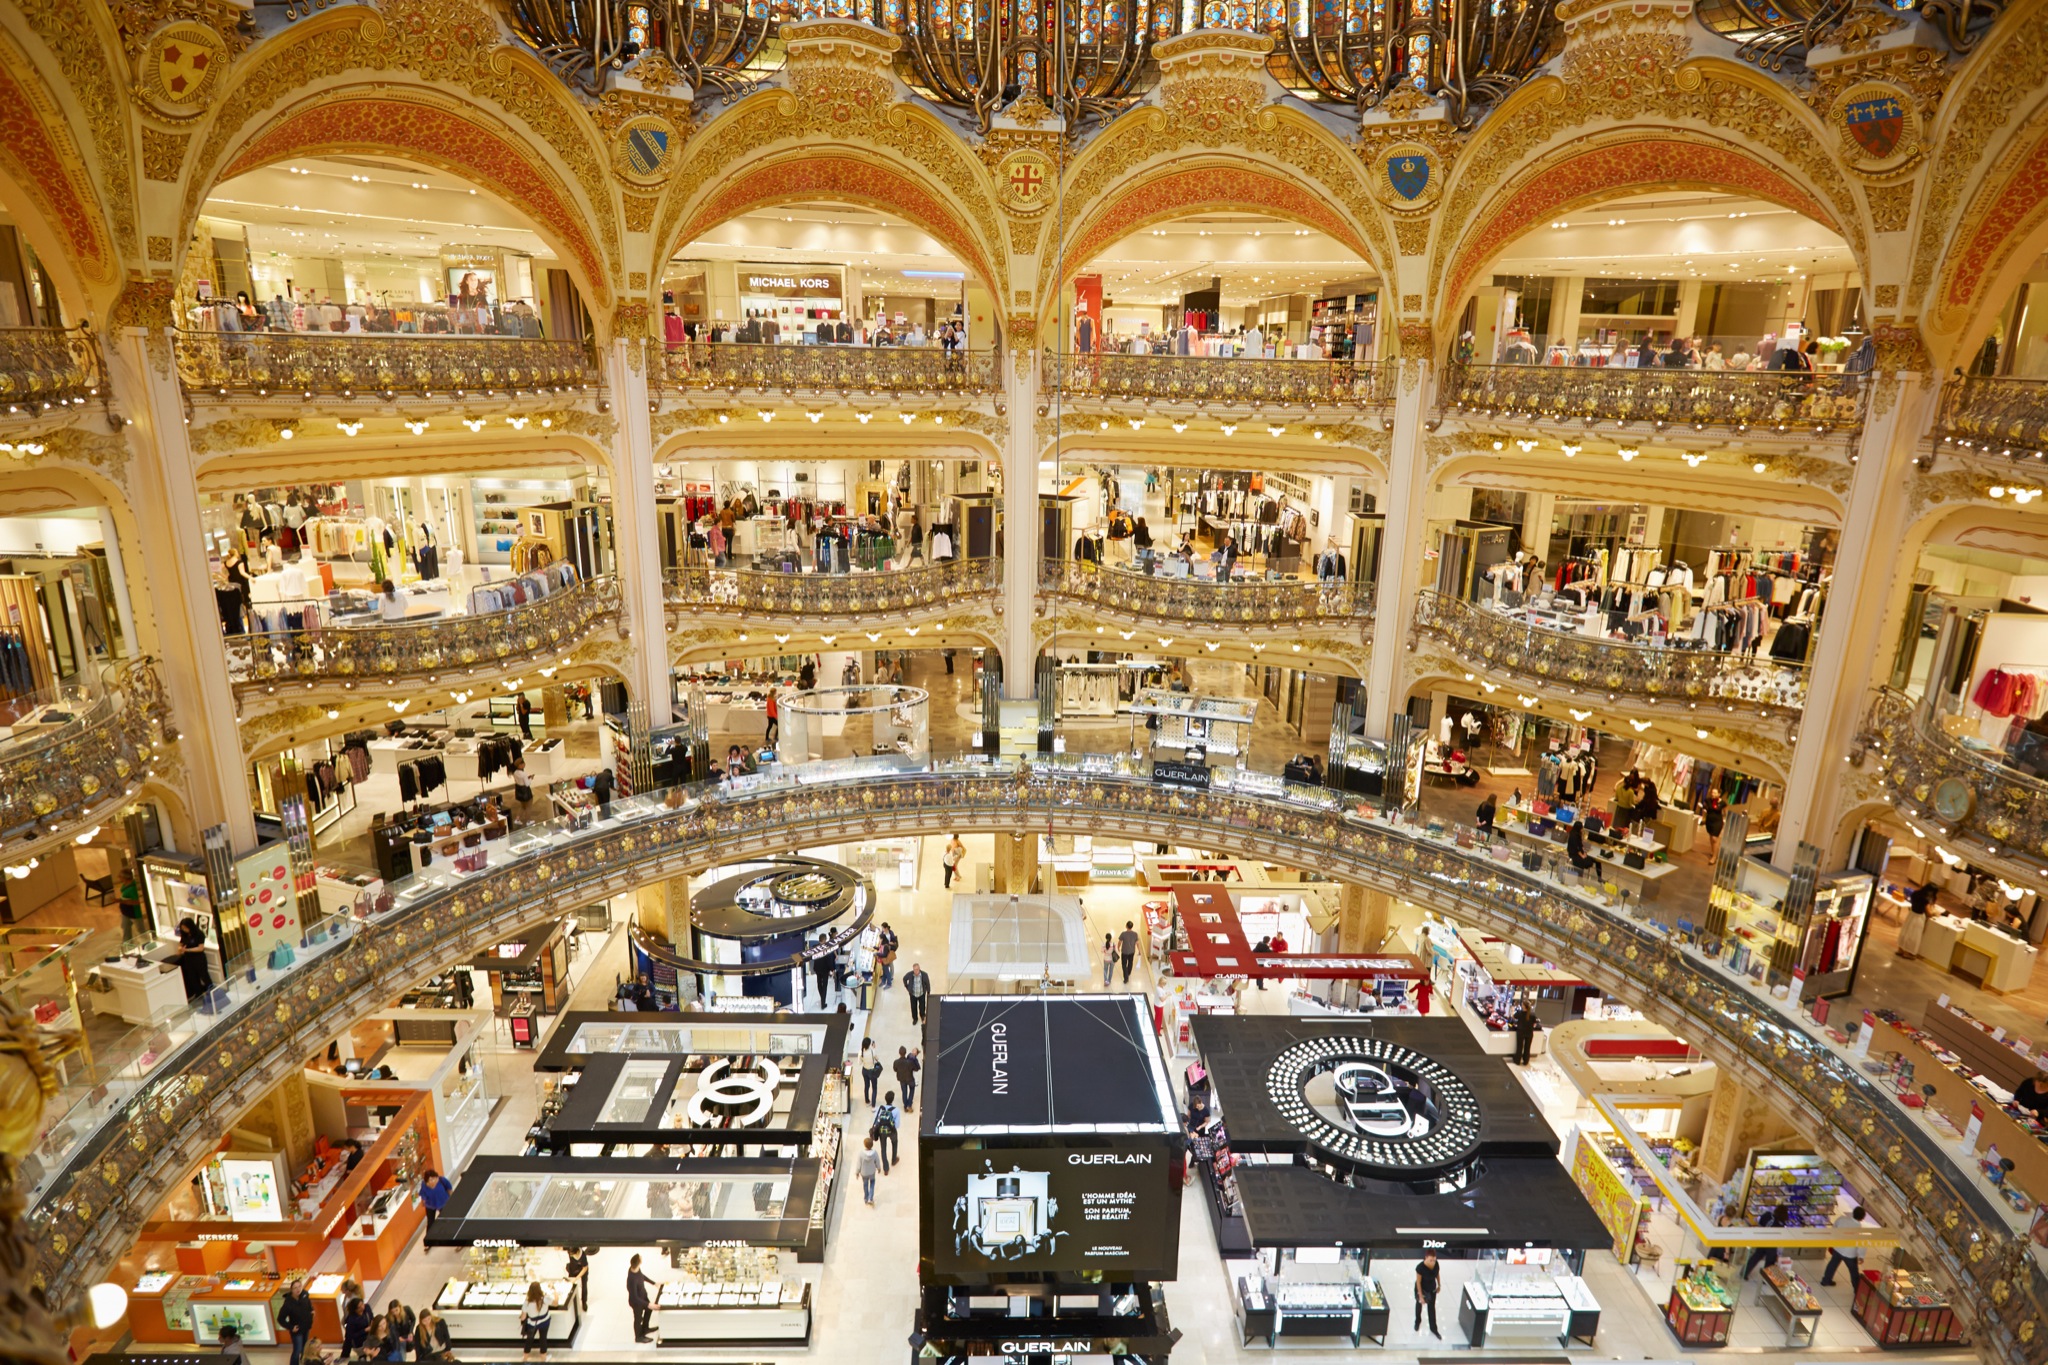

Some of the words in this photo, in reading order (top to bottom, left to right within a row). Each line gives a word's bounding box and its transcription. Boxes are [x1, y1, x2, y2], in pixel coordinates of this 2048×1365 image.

[749, 277, 797, 288] MICHAEL
[800, 278, 830, 289] KORS
[1155, 768, 1208, 783] GUERLAIN
[150, 864, 181, 876] DELVAUX
[829, 927, 857, 946] LAUDER
[990, 1022, 1008, 1095] GUERLAIN
[1068, 1154, 1152, 1165] GUERLAIN
[1589, 1161, 1616, 1204] Brasil
[1117, 1191, 1136, 1199] IDÉAL
[473, 1239, 520, 1247] CHANEL
[1423, 1240, 1447, 1248] Dior
[1001, 1342, 1091, 1353] GUERLAIN
